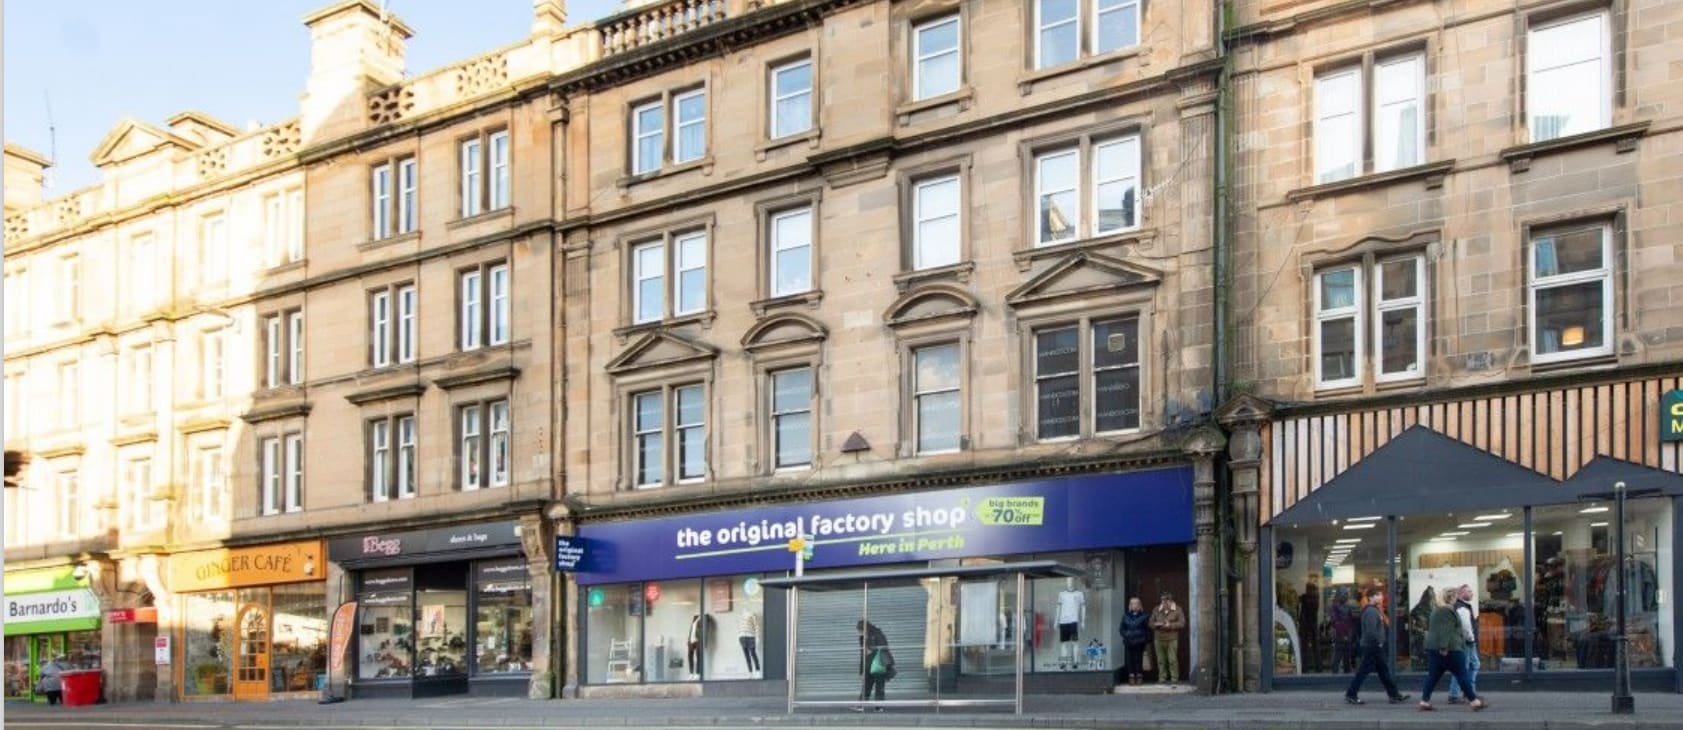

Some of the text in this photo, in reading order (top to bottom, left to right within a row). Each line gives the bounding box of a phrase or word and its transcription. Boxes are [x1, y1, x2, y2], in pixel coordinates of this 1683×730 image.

[1006, 499, 1039, 508] brands
[676, 505, 966, 548] the original factory shop
[858, 535, 966, 556] Here in Perth
[195, 553, 293, 581] GINGER CAFÉ
[9, 597, 77, 617] Barnardo's
